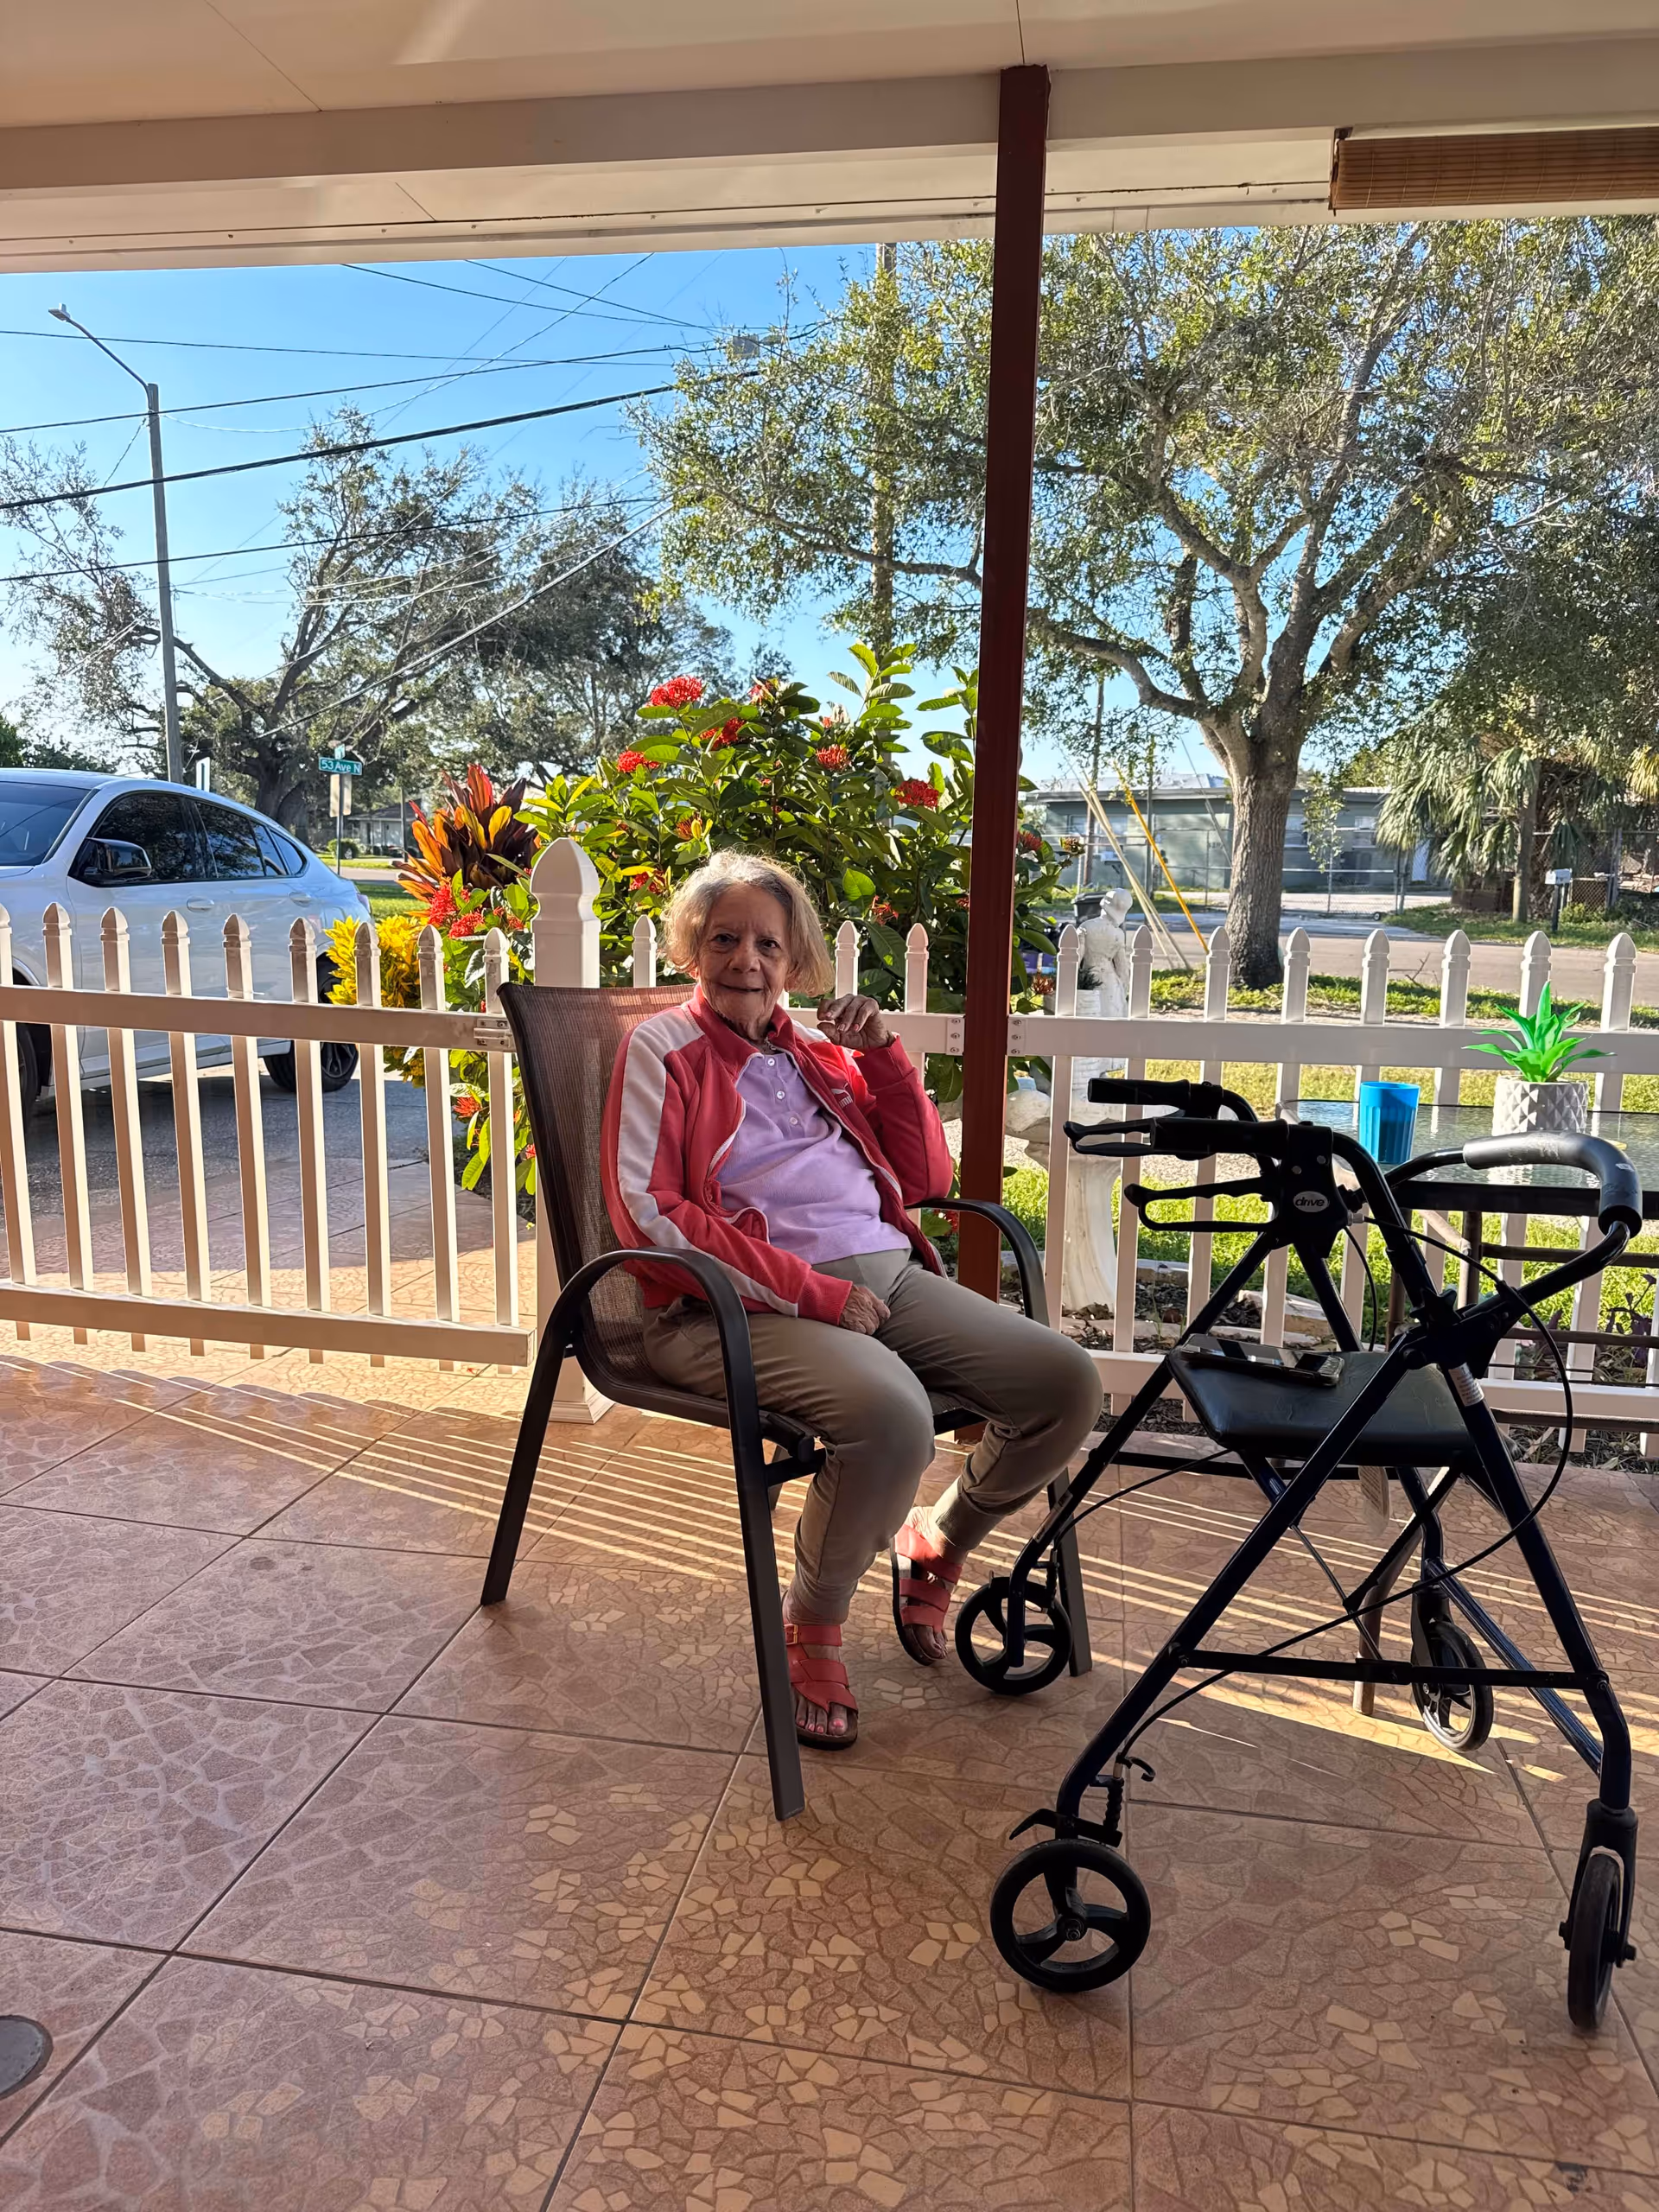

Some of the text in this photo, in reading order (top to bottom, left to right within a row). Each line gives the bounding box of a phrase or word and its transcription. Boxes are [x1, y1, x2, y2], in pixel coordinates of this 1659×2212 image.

[321, 760, 360, 773] 53 Ave N
[1295, 1197, 1325, 1207] drive
